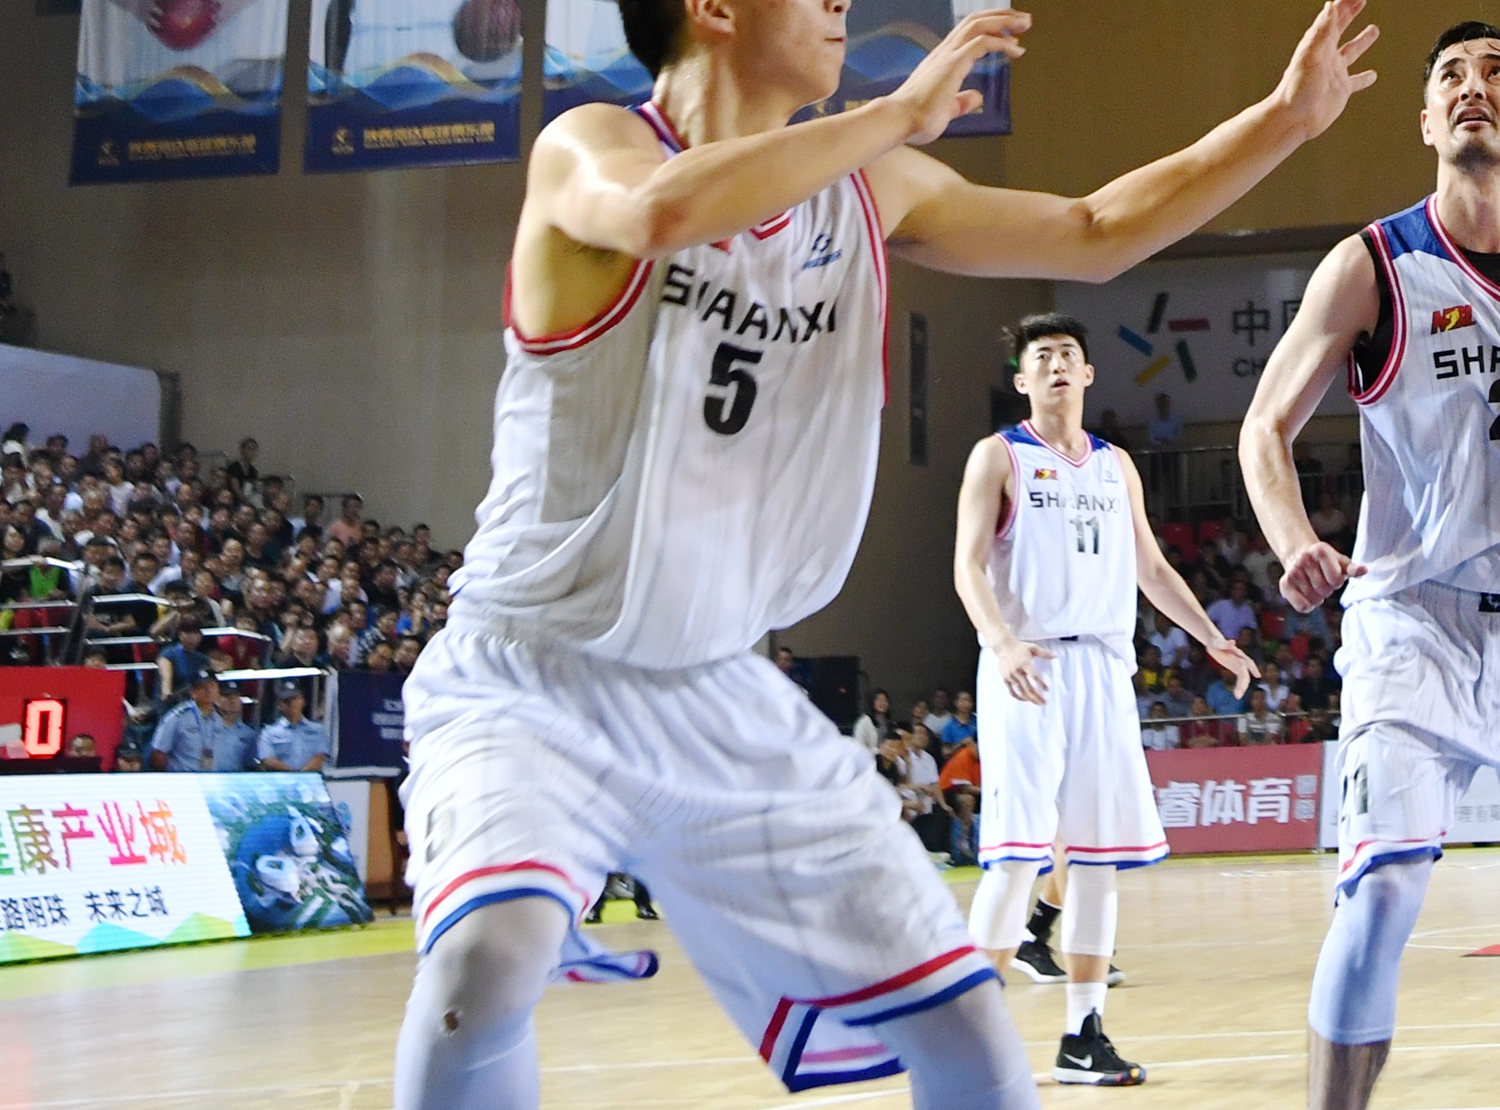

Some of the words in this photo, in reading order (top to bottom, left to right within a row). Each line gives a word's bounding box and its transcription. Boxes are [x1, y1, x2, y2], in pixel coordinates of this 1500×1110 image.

[661, 263, 837, 344] SAANXI
[702, 341, 764, 436] 5
[1029, 490, 1120, 514] SHANX
[1069, 514, 1100, 555] 11
[25, 698, 65, 757] 0
[0, 893, 70, 931] 路明珠
